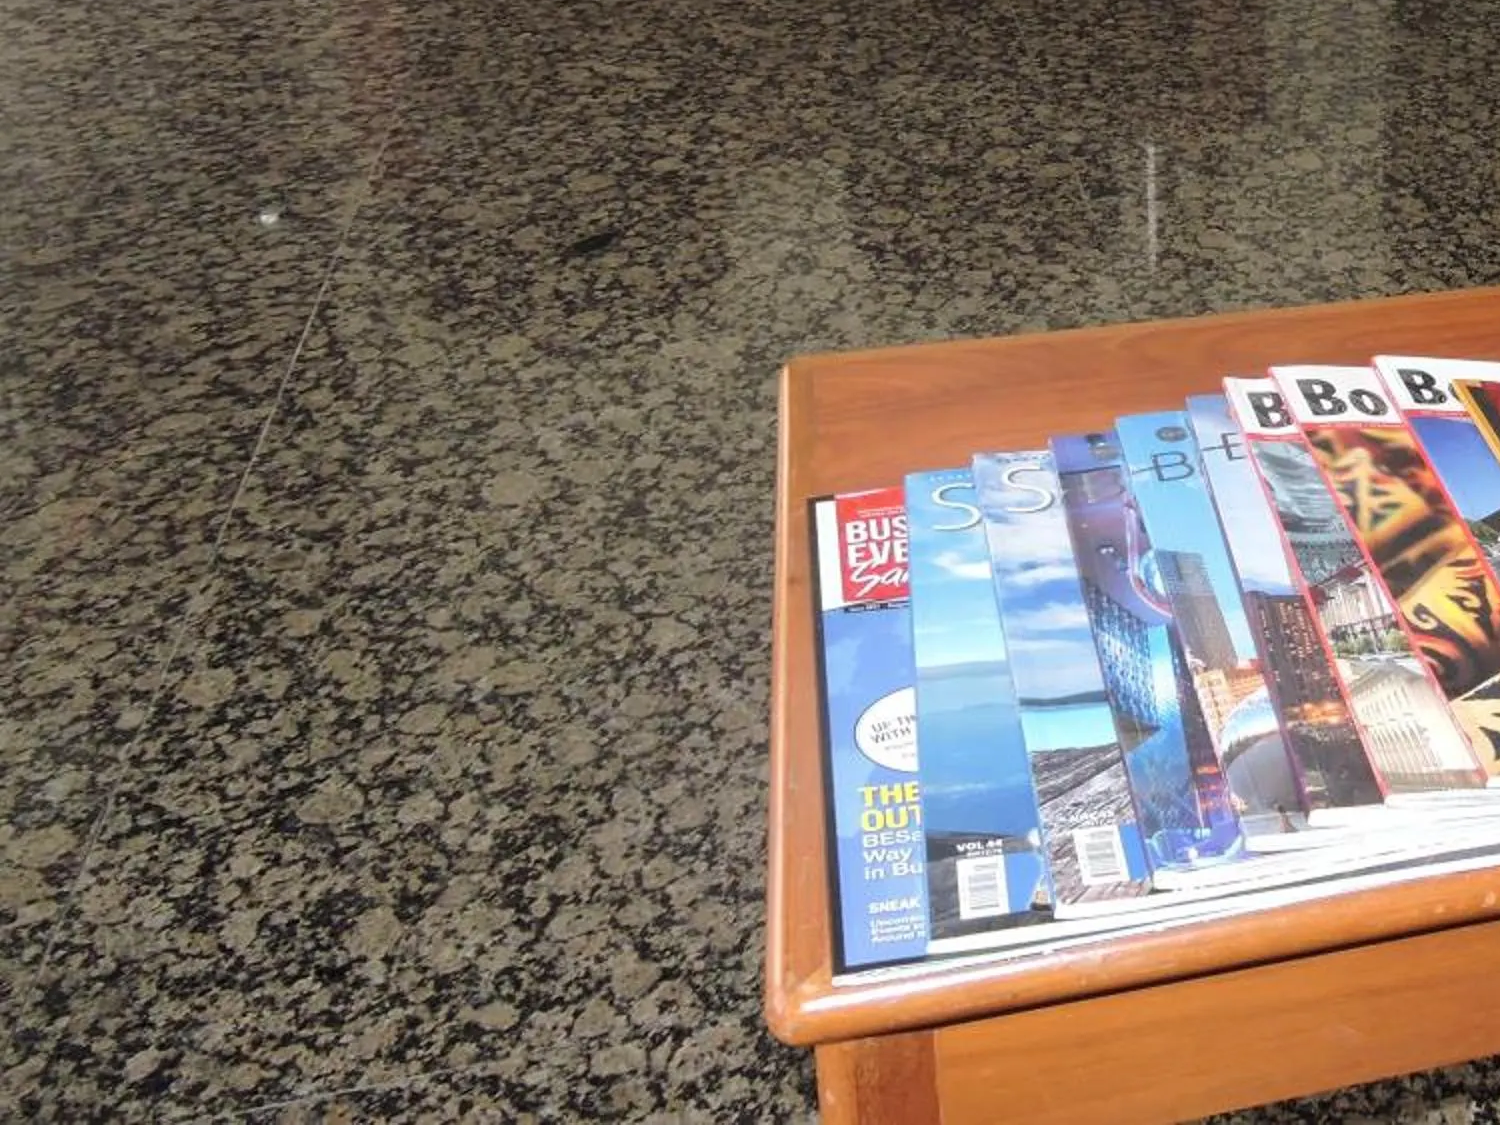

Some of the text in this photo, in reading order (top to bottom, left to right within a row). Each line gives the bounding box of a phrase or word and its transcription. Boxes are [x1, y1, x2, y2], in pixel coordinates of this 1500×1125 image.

[1296, 379, 1389, 416] Bo
[1398, 369, 1462, 404] B
[1247, 392, 1293, 427] B
[931, 482, 983, 531] S
[1001, 465, 1054, 513] S
[857, 779, 920, 807] THE
[863, 846, 913, 866] Way
